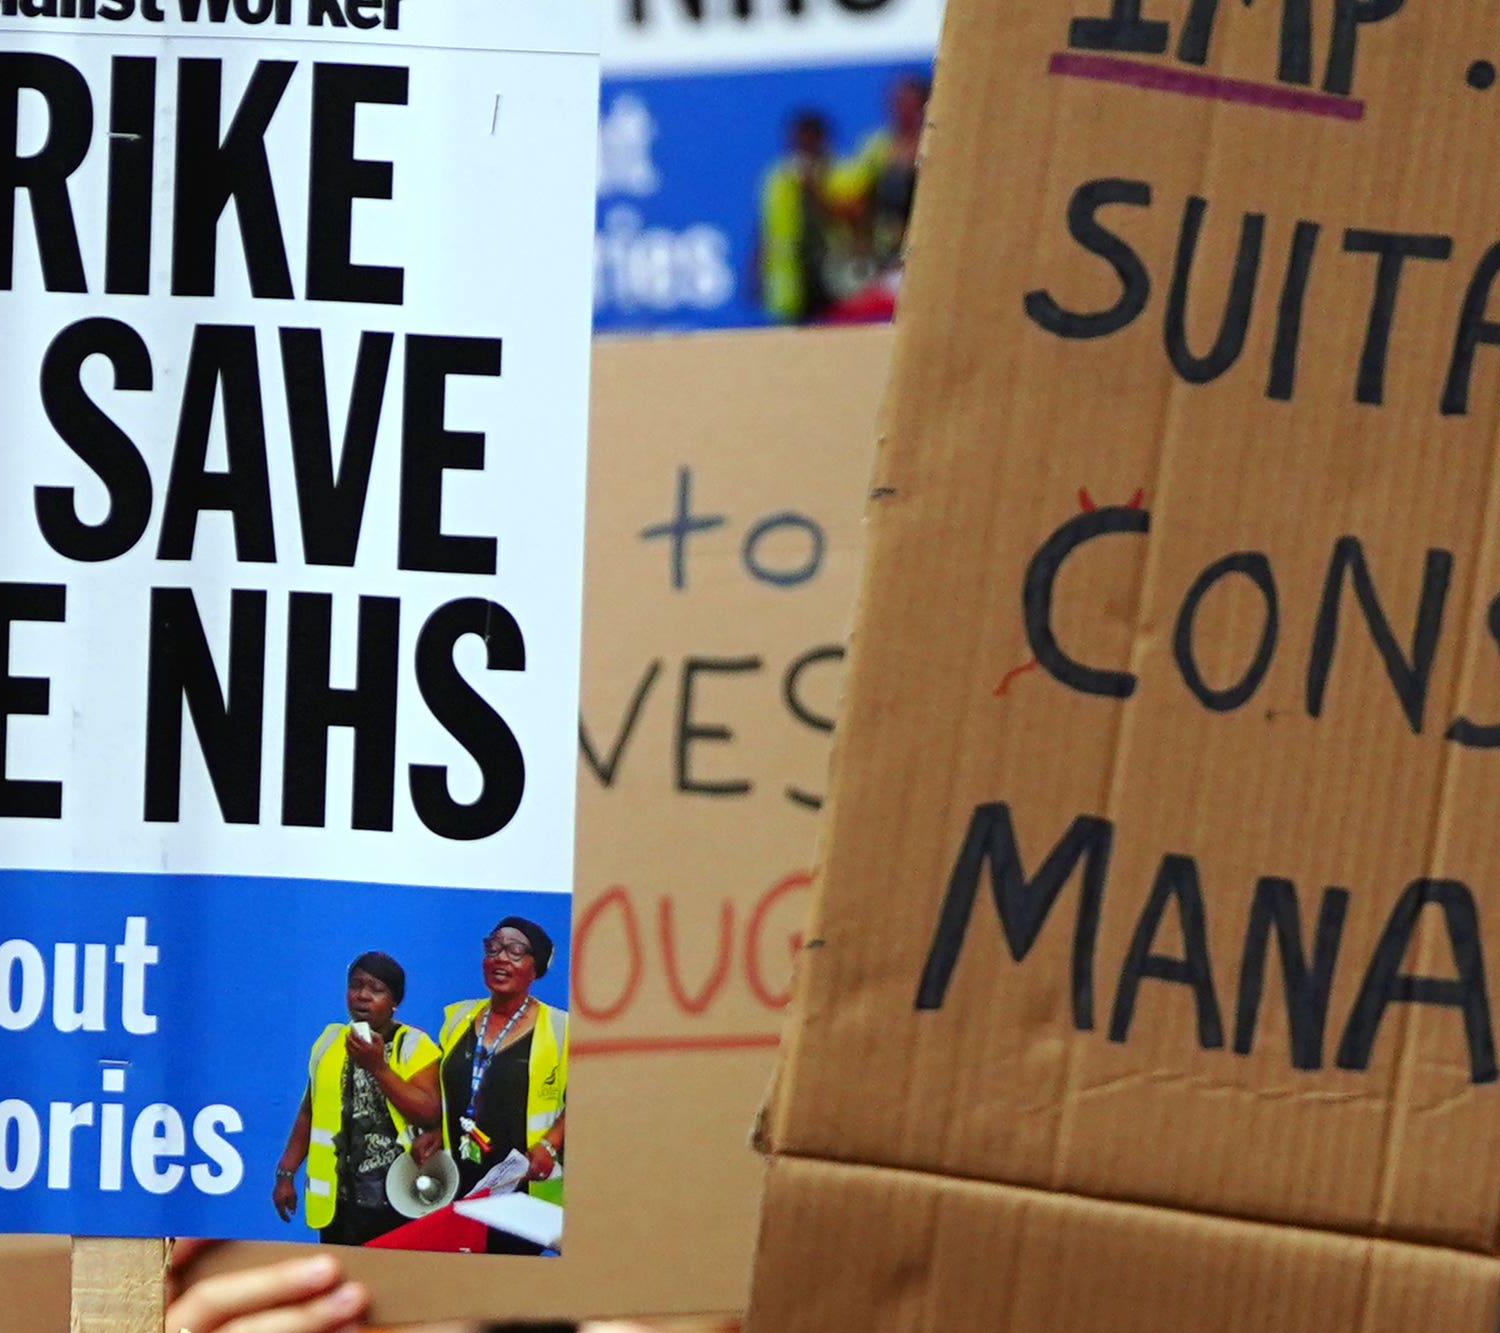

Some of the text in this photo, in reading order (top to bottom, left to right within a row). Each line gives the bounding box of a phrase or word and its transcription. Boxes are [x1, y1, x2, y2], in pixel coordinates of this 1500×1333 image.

[34, 316, 503, 575] SAVE
[638, 464, 826, 591] to
[143, 586, 527, 841] NHS
